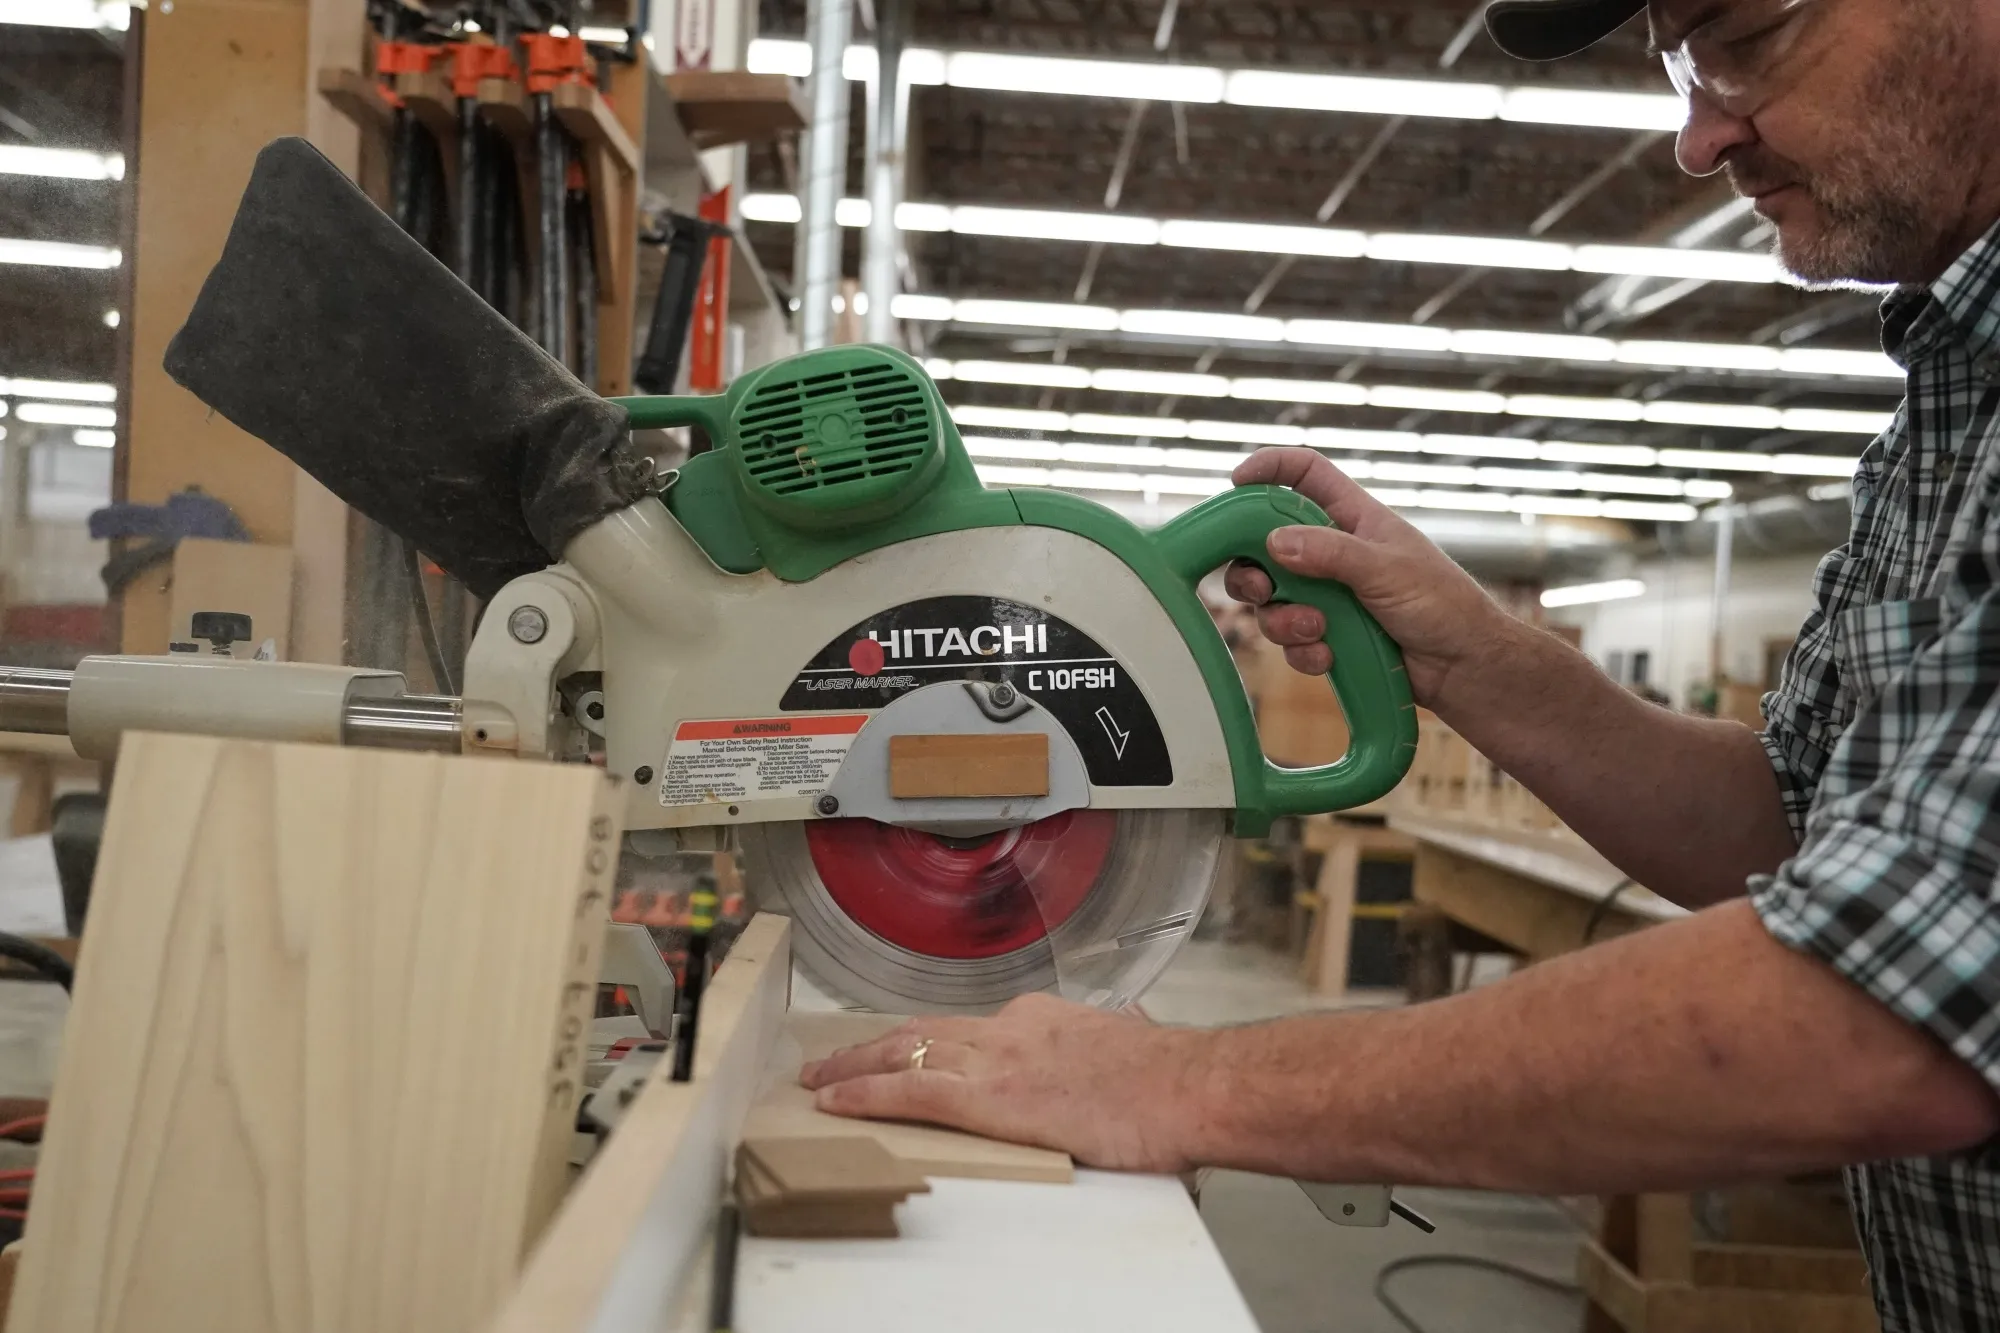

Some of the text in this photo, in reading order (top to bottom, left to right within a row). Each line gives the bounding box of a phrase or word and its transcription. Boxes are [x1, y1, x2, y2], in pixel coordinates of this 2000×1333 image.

[868, 623, 1048, 660] HITACHI
[798, 675, 919, 690] LASER MARKER
[1028, 667, 1116, 691] C 10FSH
[741, 723, 791, 733] WARNING
